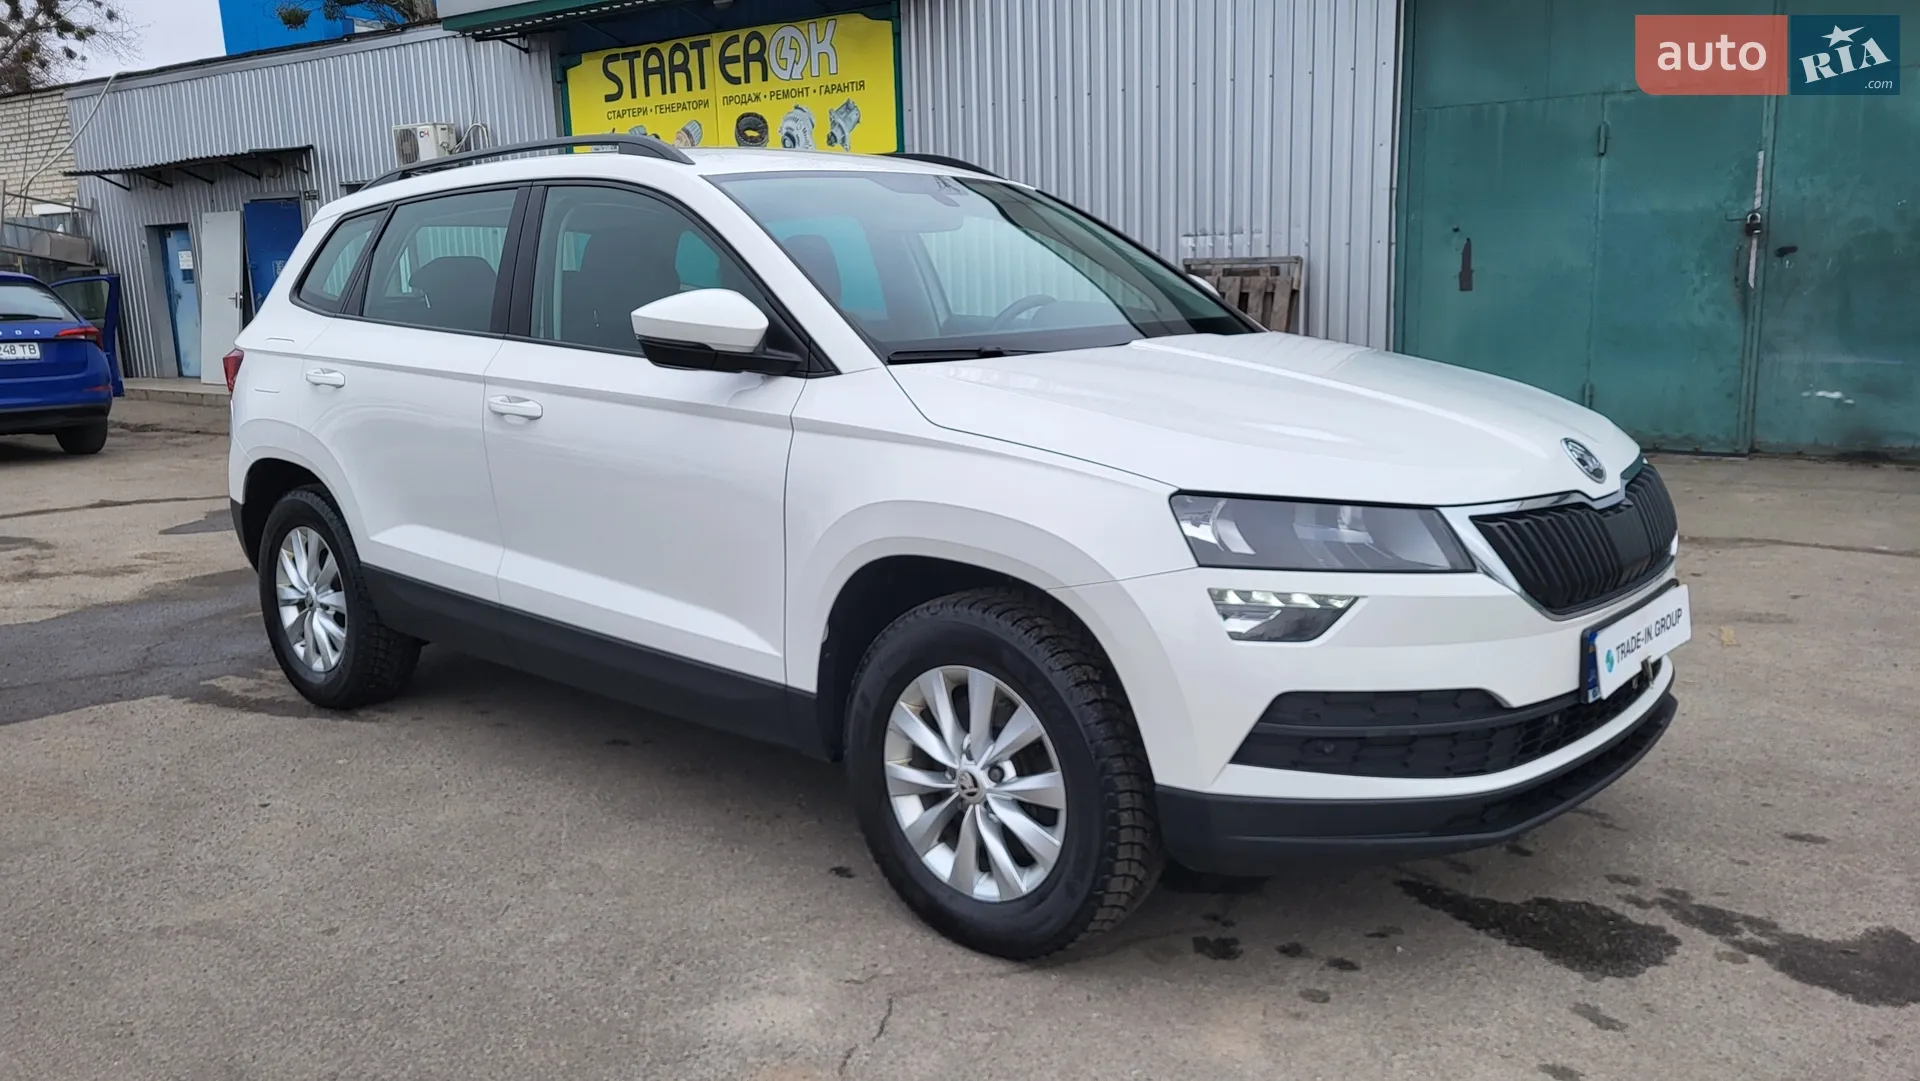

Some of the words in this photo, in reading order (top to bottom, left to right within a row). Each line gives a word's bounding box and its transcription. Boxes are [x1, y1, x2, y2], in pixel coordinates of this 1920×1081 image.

[722, 92, 762, 106] ПРОДАЖ
[769, 86, 810, 101] РЕМОНТ
[819, 80, 866, 96] ГАРАНТІЯ
[606, 106, 649, 120] СТАРТЕРИ
[654, 99, 710, 114] ГЕНЕРАТОРИ
[1615, 624, 1654, 664] TRADE-IN
[1654, 608, 1682, 638] GROUP
